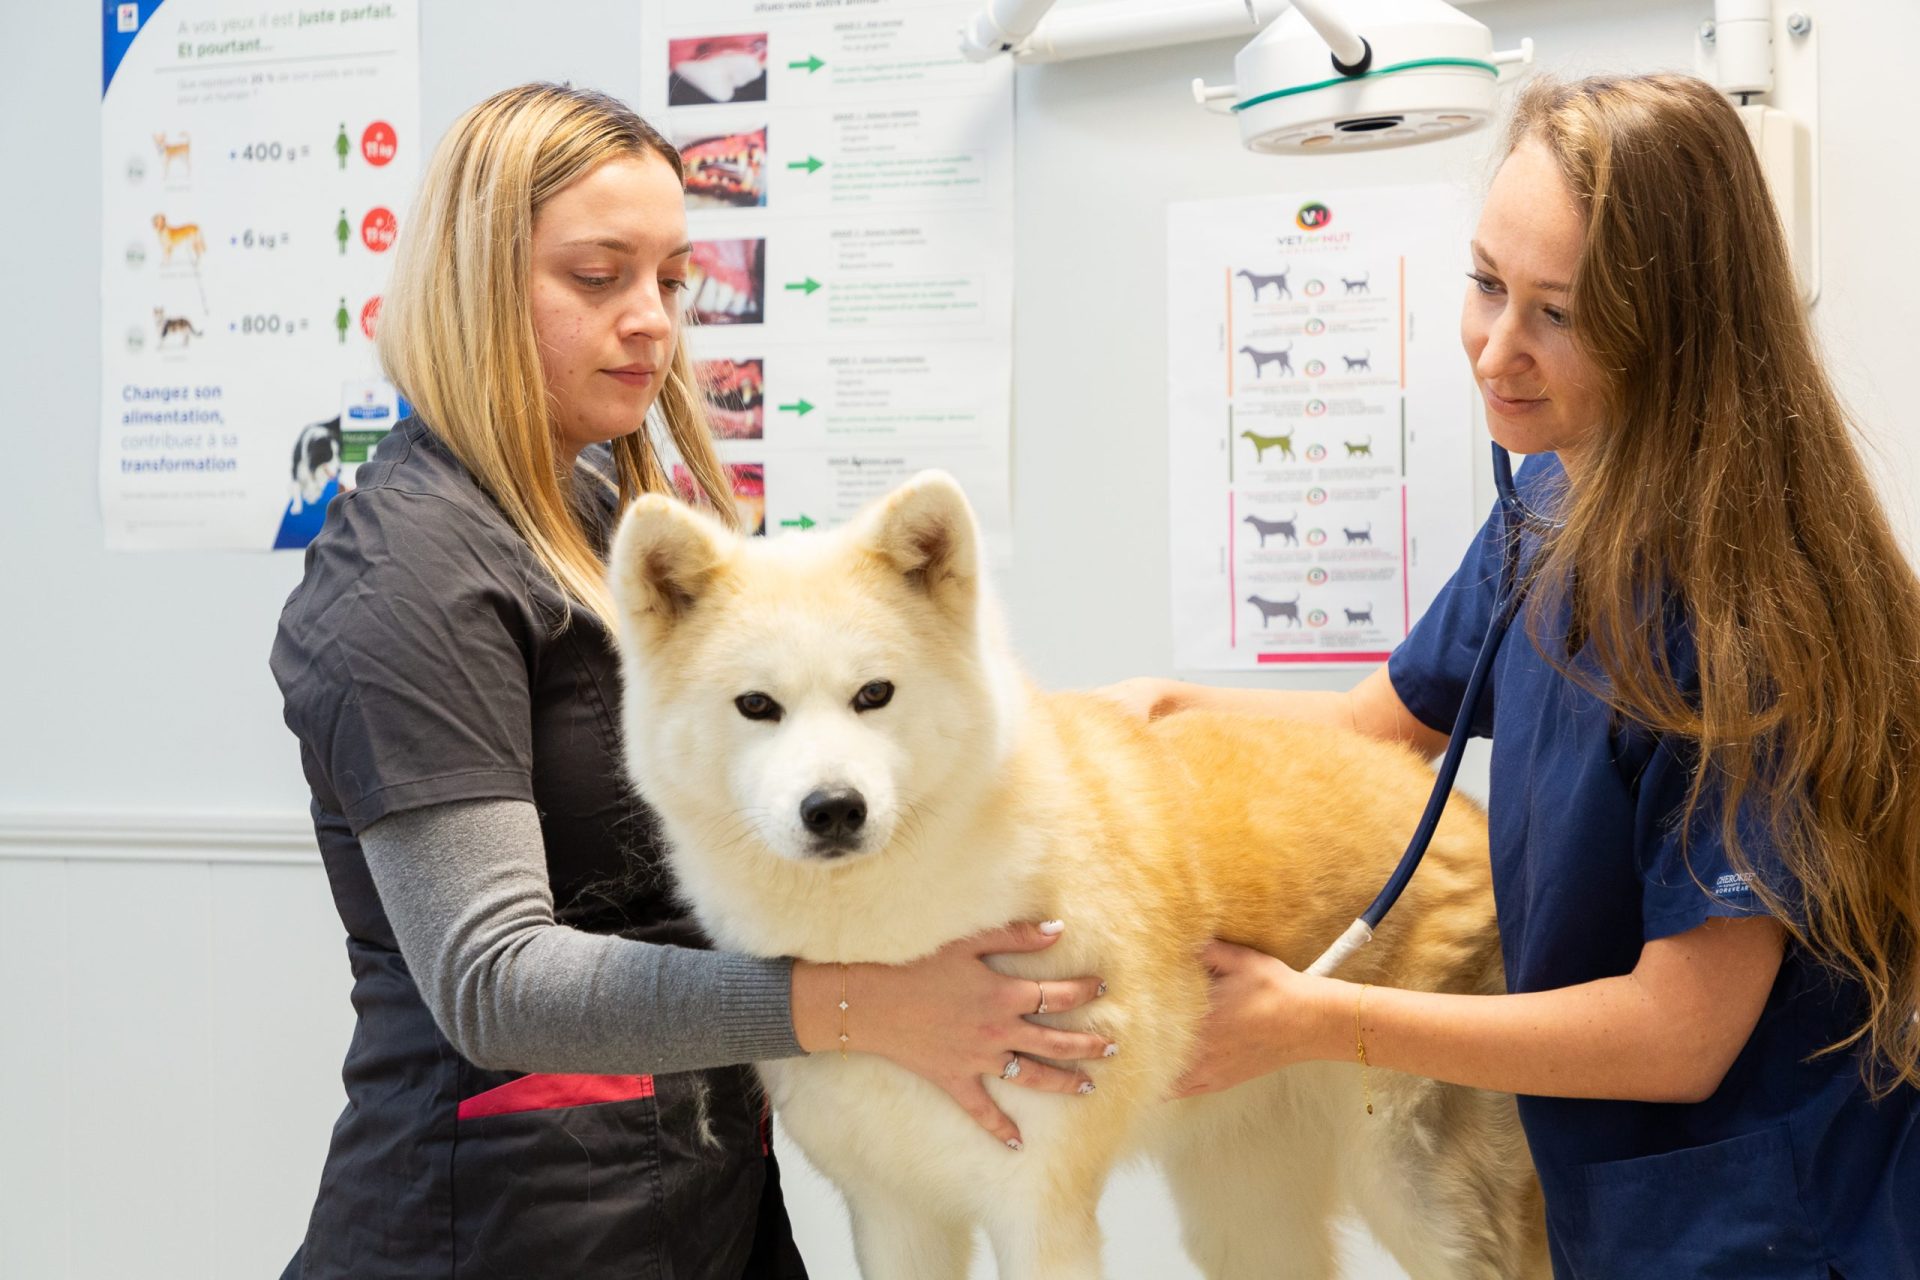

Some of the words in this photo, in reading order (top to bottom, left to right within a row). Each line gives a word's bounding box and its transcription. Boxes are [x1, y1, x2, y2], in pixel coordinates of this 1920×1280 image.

[297, 11, 335, 29] juste
[341, 4, 397, 23] parfait.
[177, 42, 193, 59] Et
[242, 142, 282, 162] 400
[242, 229, 253, 249] 6
[259, 231, 275, 250] kg
[241, 315, 281, 334] 800
[122, 385, 189, 403] Changez
[195, 385, 222, 399] son
[122, 409, 224, 426] alimentation,
[120, 432, 201, 450] contribuez
[222, 435, 238, 449] sa
[121, 456, 237, 473] transformation
